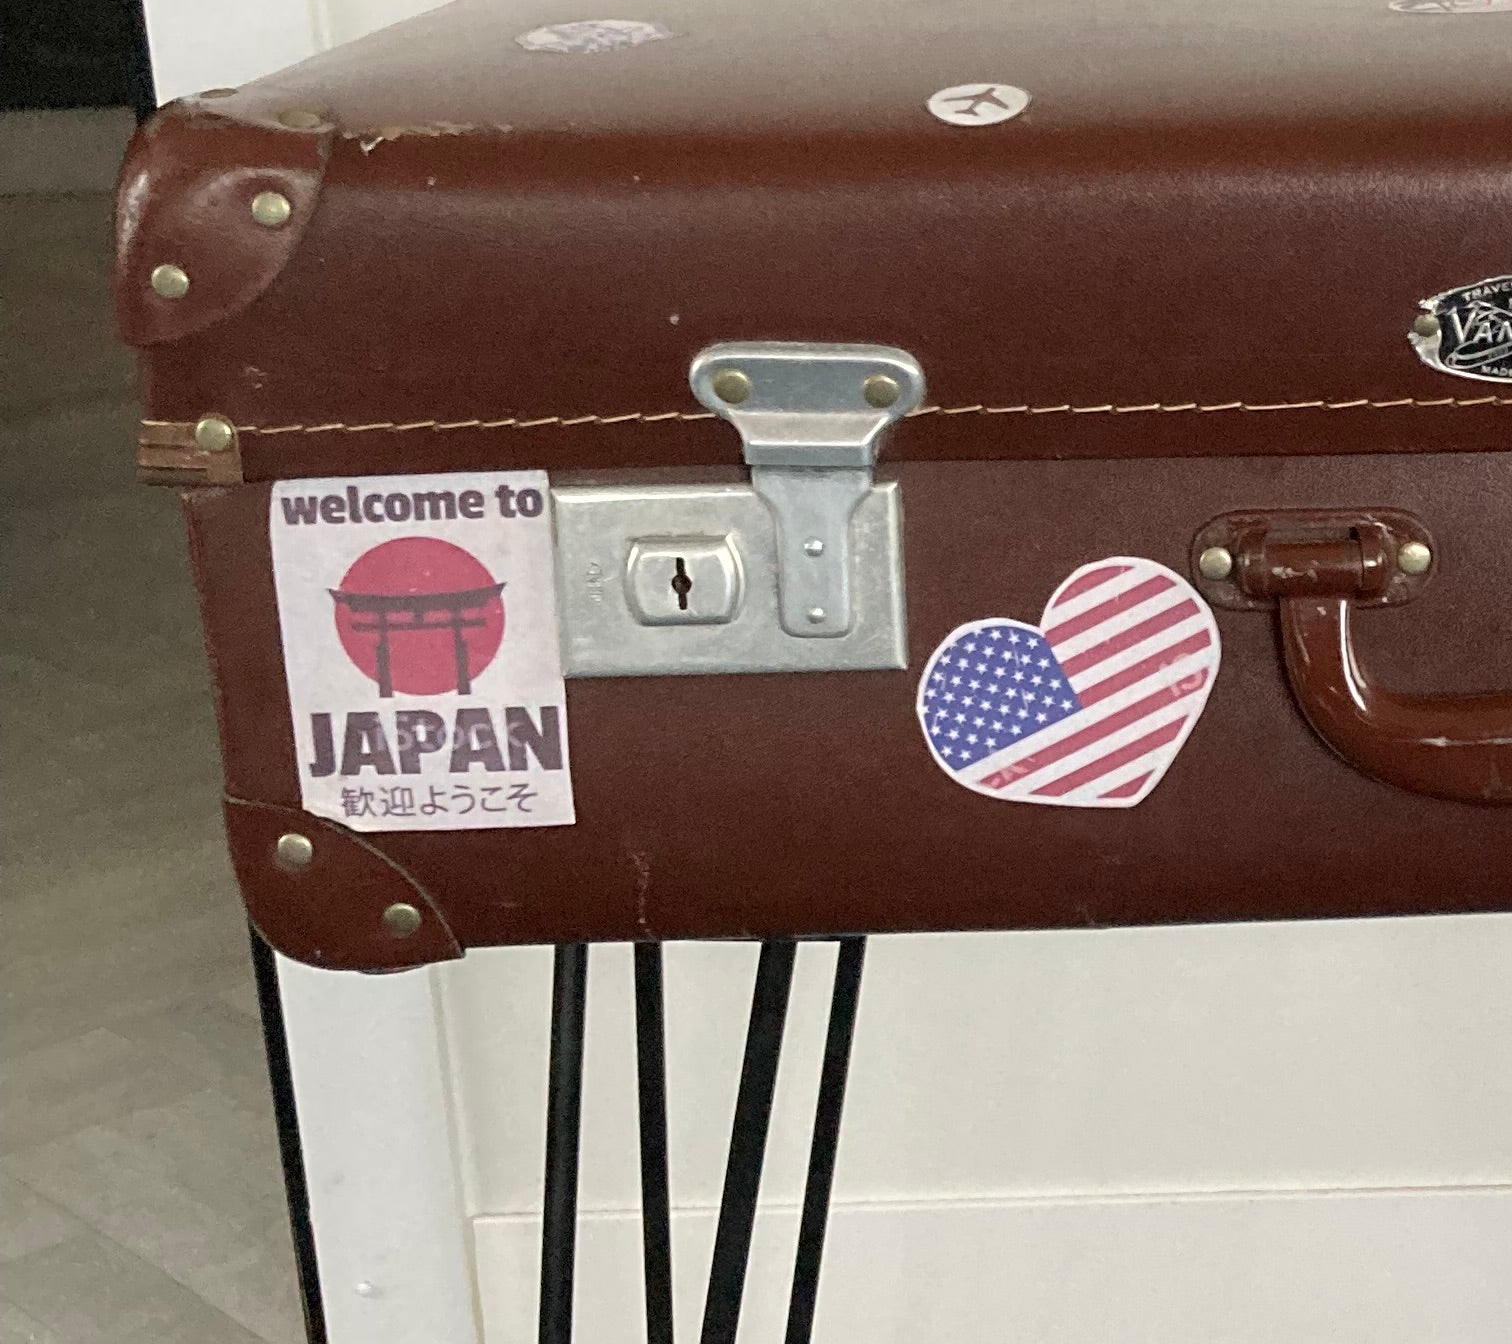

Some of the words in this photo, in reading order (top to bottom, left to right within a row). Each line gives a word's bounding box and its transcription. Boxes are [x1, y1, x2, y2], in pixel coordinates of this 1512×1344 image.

[281, 484, 487, 526] welcome
[495, 483, 544, 520] to
[308, 705, 563, 778] JAPAN
[341, 782, 540, 820] 歓迎ようこそ
